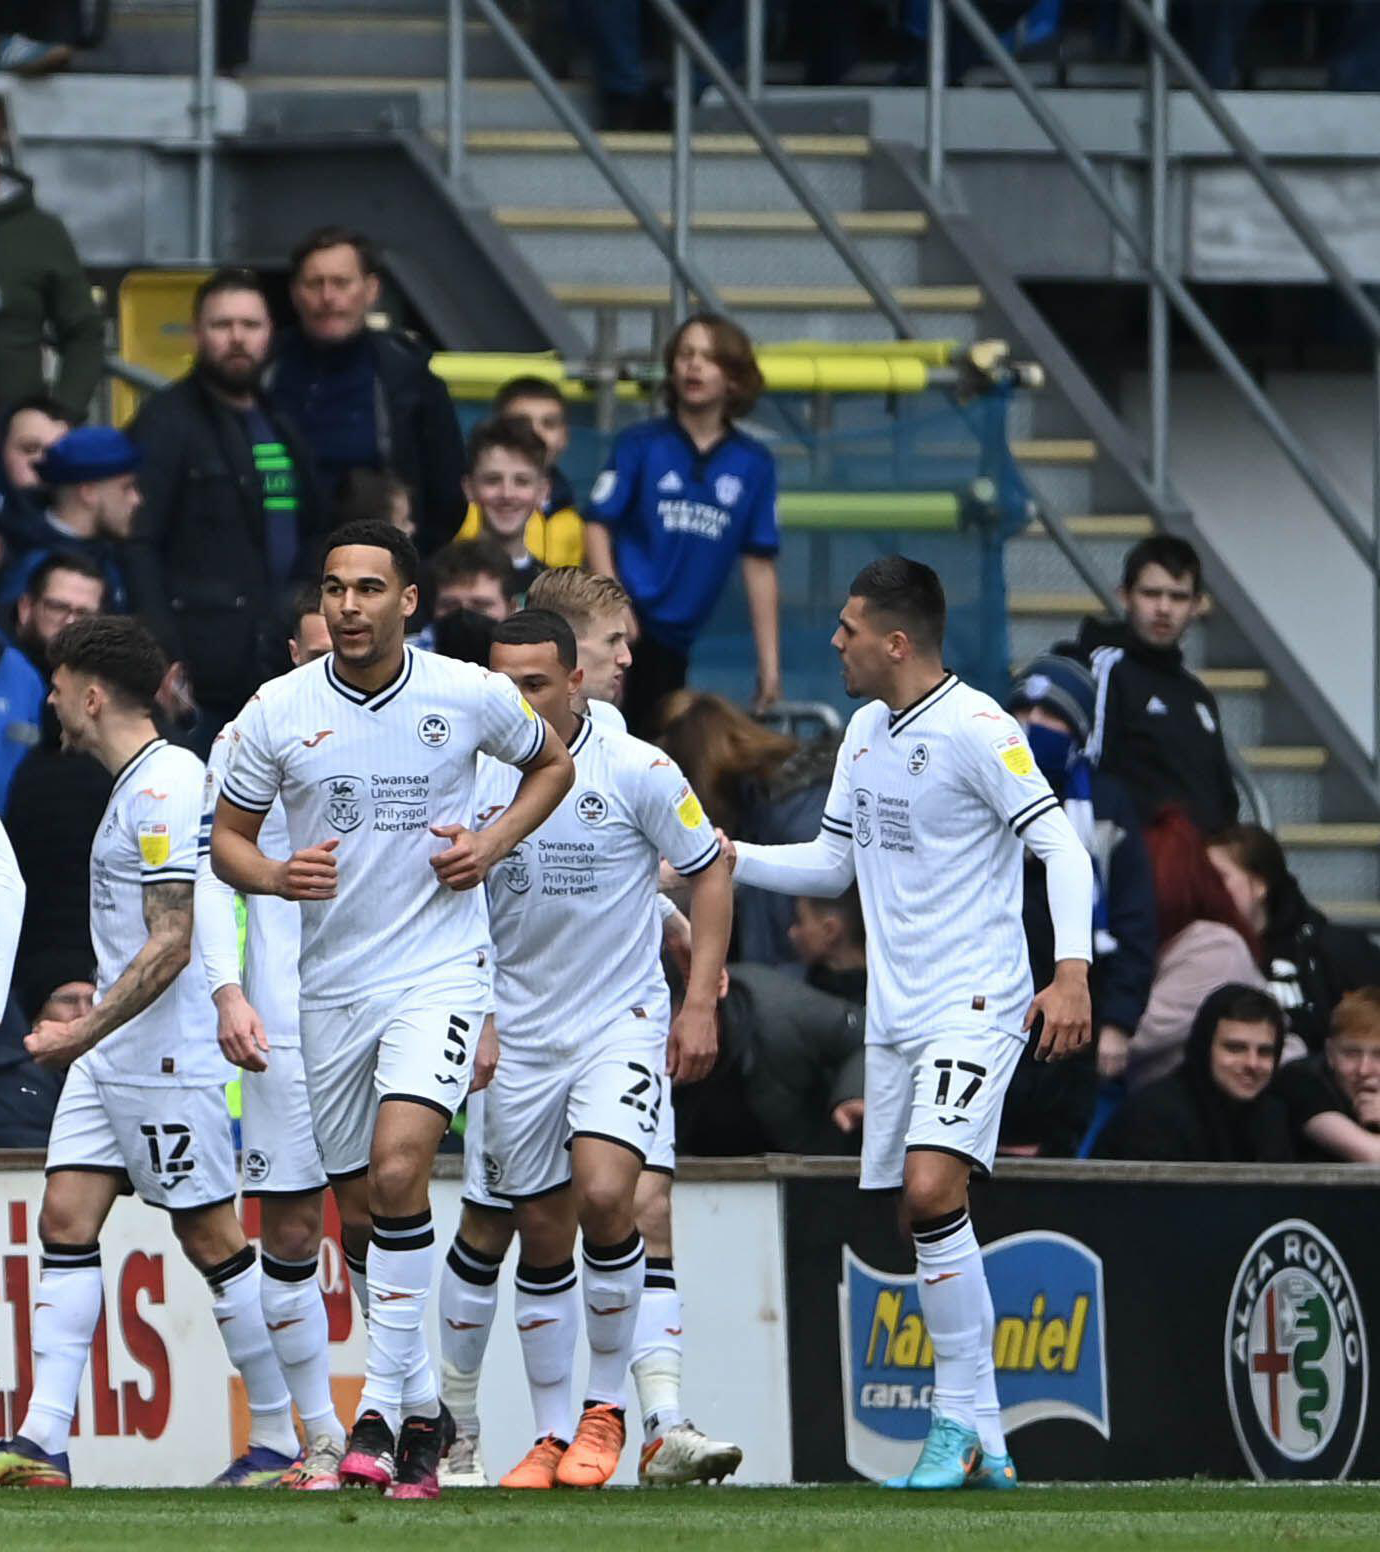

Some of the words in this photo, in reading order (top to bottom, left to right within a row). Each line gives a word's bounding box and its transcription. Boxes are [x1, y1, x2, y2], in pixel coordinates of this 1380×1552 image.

[371, 774, 429, 786] Swansea
[371, 787, 429, 799] University
[373, 820, 429, 832] Abertawe
[538, 840, 595, 851] Swansea
[538, 852, 595, 865] University
[541, 885, 598, 896] Abertawe
[444, 1014, 469, 1066] 5
[934, 1059, 986, 1109] 17
[140, 1124, 194, 1173] 12
[1233, 1250, 1274, 1364] ALFA
[1284, 1233, 1360, 1366] ROMEO
[866, 1290, 1088, 1371] Naniel
